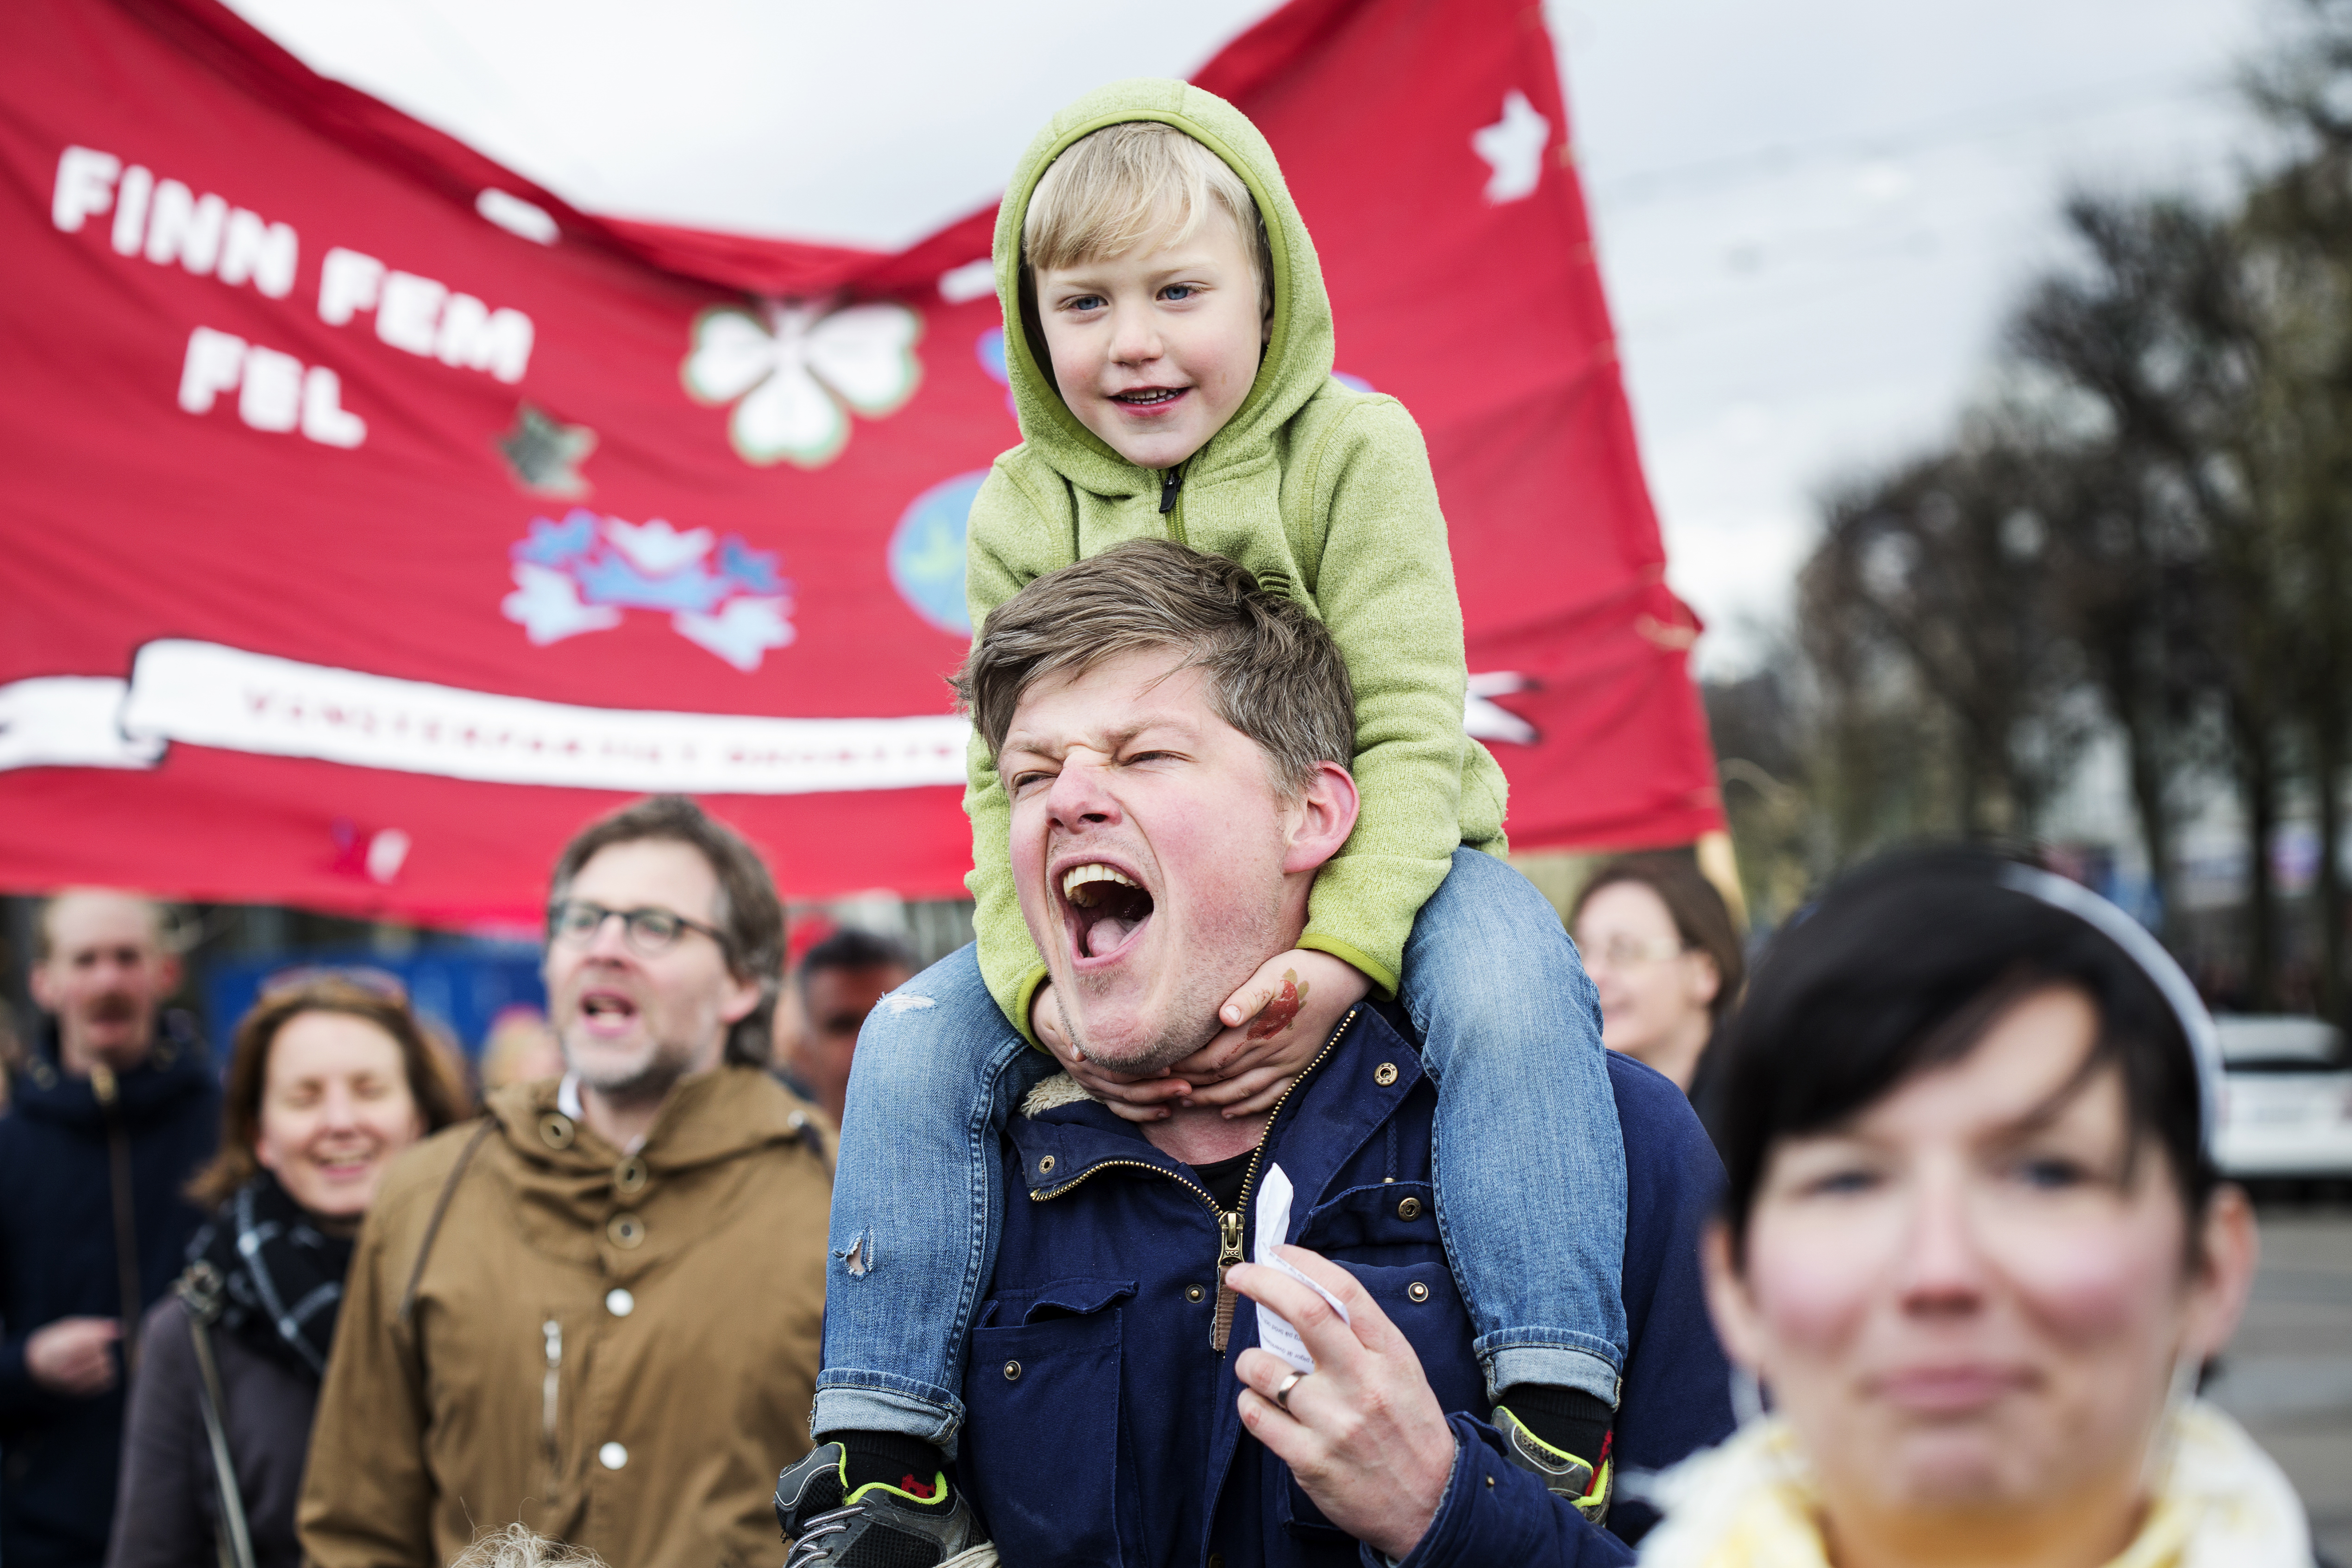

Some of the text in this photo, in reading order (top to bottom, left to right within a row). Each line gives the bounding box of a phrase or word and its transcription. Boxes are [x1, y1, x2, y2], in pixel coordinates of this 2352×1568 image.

[52, 144, 535, 384] FINN FEM
[1295, 1354, 1310, 1362] pigor
